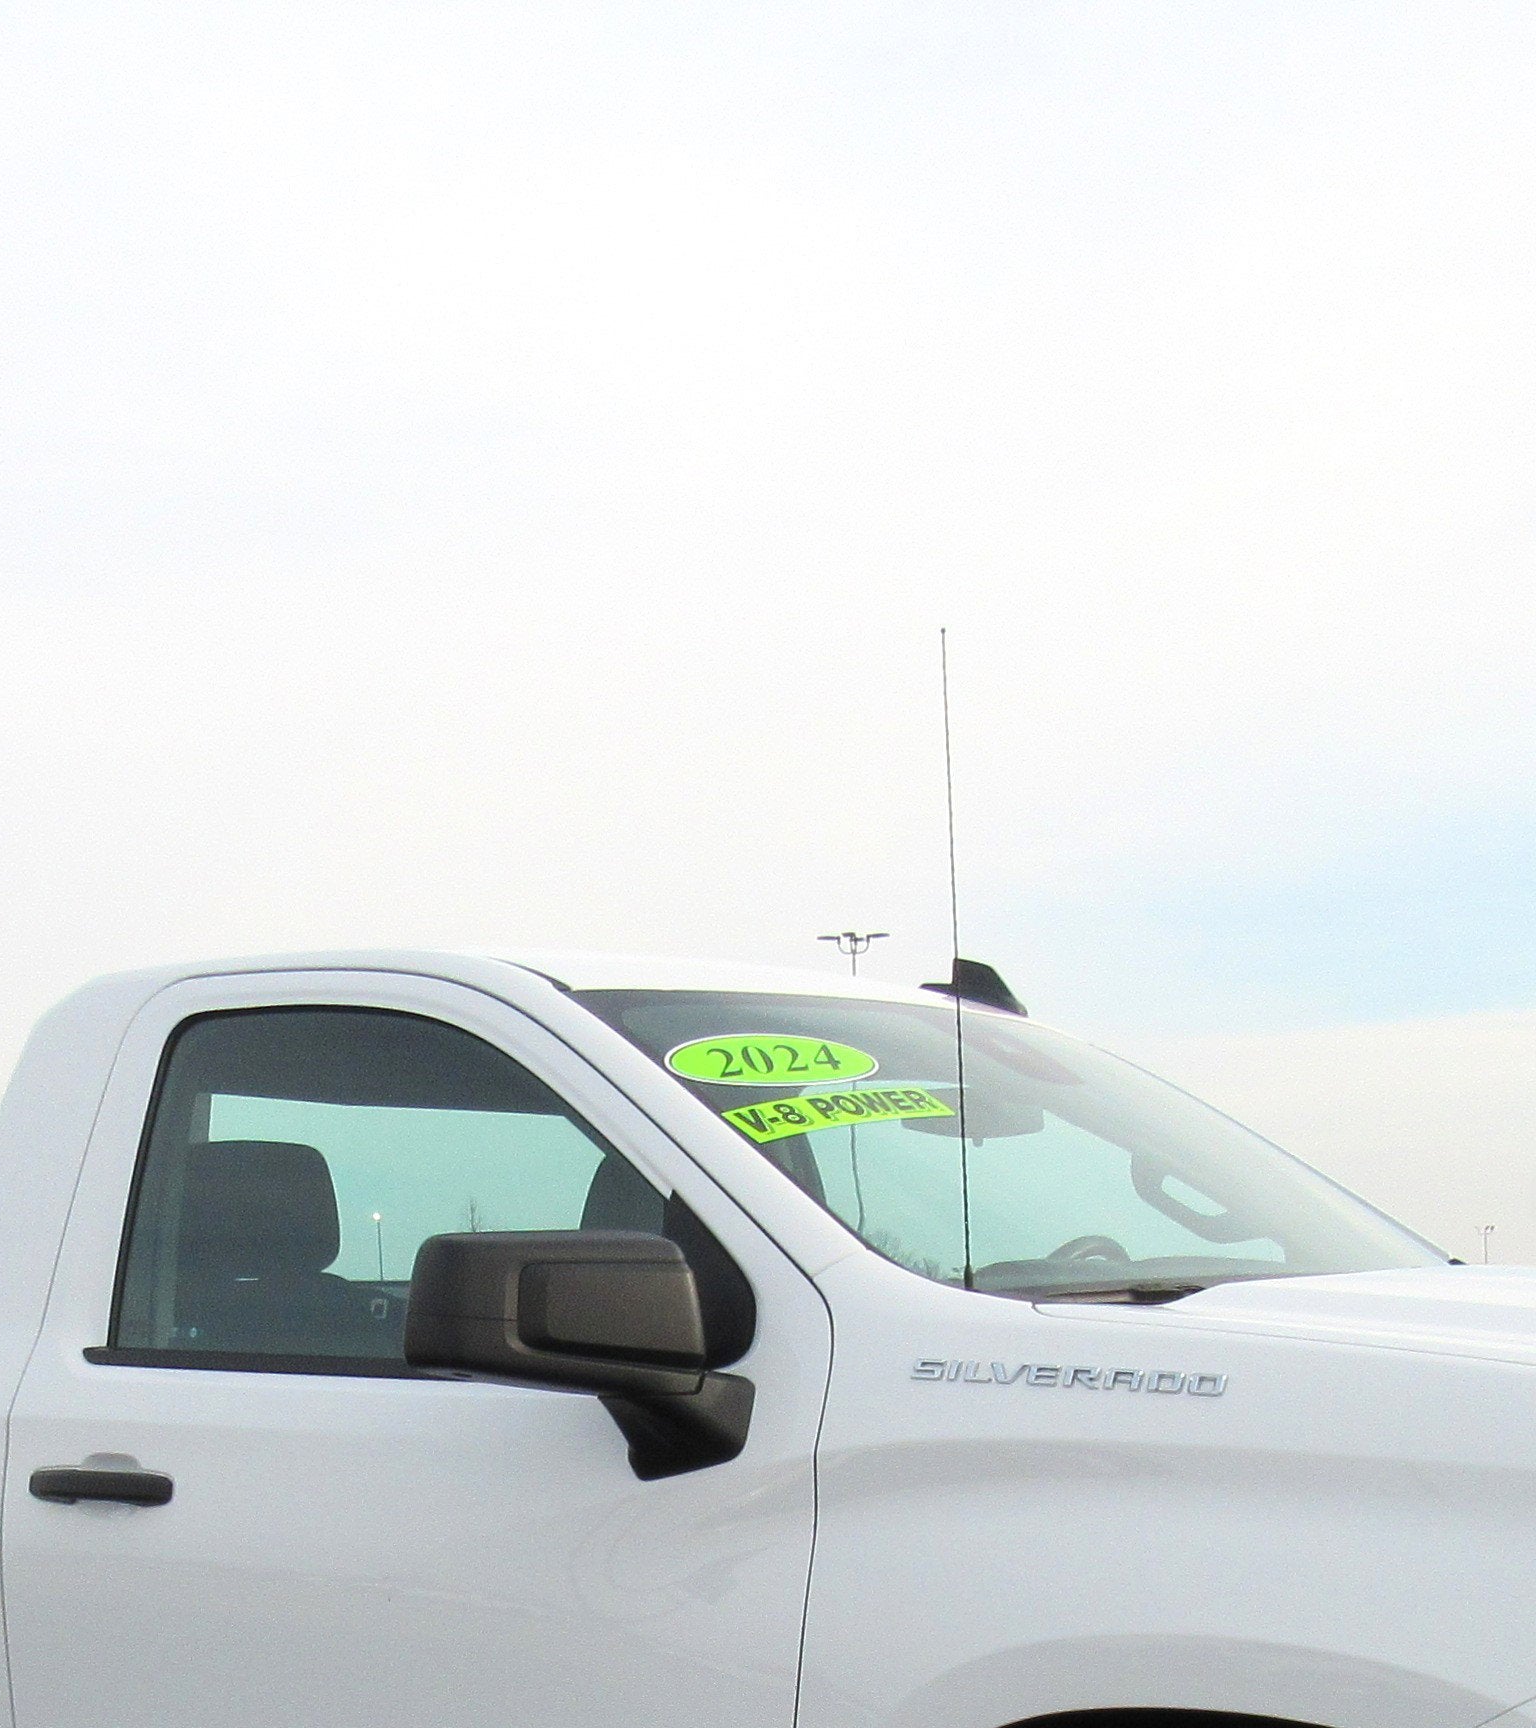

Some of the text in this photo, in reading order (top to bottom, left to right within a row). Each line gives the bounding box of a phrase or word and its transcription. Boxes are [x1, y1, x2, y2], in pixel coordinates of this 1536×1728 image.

[706, 1044, 841, 1077] 2024
[734, 1088, 943, 1135] V-8 POWER
[910, 1357, 1228, 1397] SILVERADO
